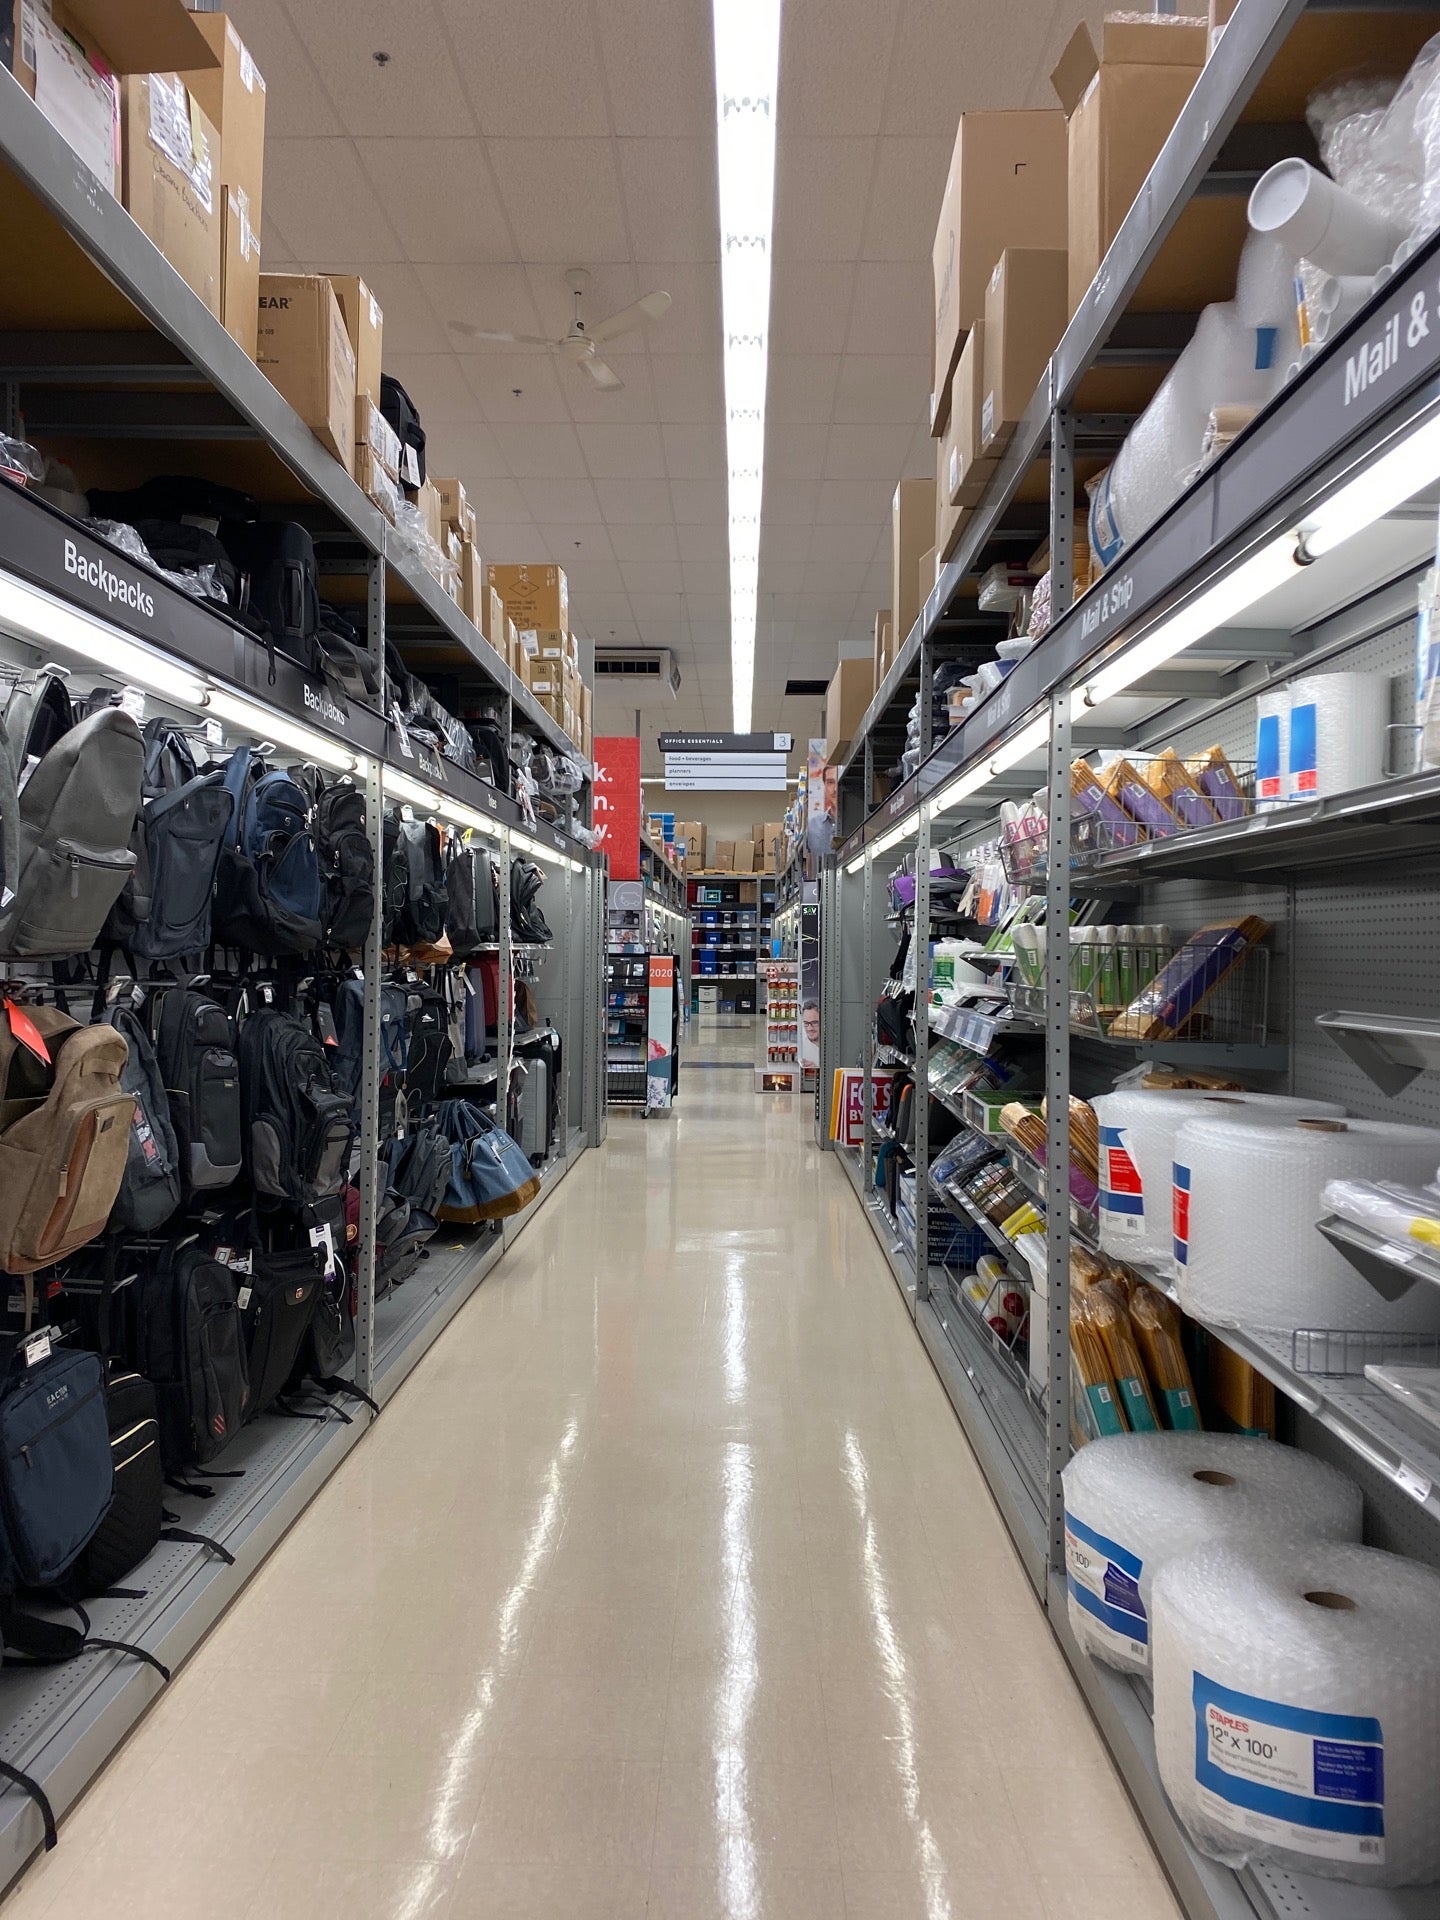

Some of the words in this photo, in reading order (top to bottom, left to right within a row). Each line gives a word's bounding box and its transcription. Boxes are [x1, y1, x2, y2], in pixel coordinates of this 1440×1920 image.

[1344, 312, 1400, 406] Mail
[1407, 291, 1430, 348] &
[64, 538, 154, 618] Backpacks
[1081, 598, 1101, 640] Mail
[1101, 593, 1110, 623] &
[1111, 574, 1134, 615] Ship
[303, 683, 346, 726] Backpacks
[778, 735, 787, 748] 3
[649, 968, 673, 978] 2020
[1209, 1708, 1250, 1734] STAPLES
[1209, 1724, 1230, 1744] 12"
[1231, 1736, 1241, 1750] x
[1245, 1738, 1278, 1760] 100'
